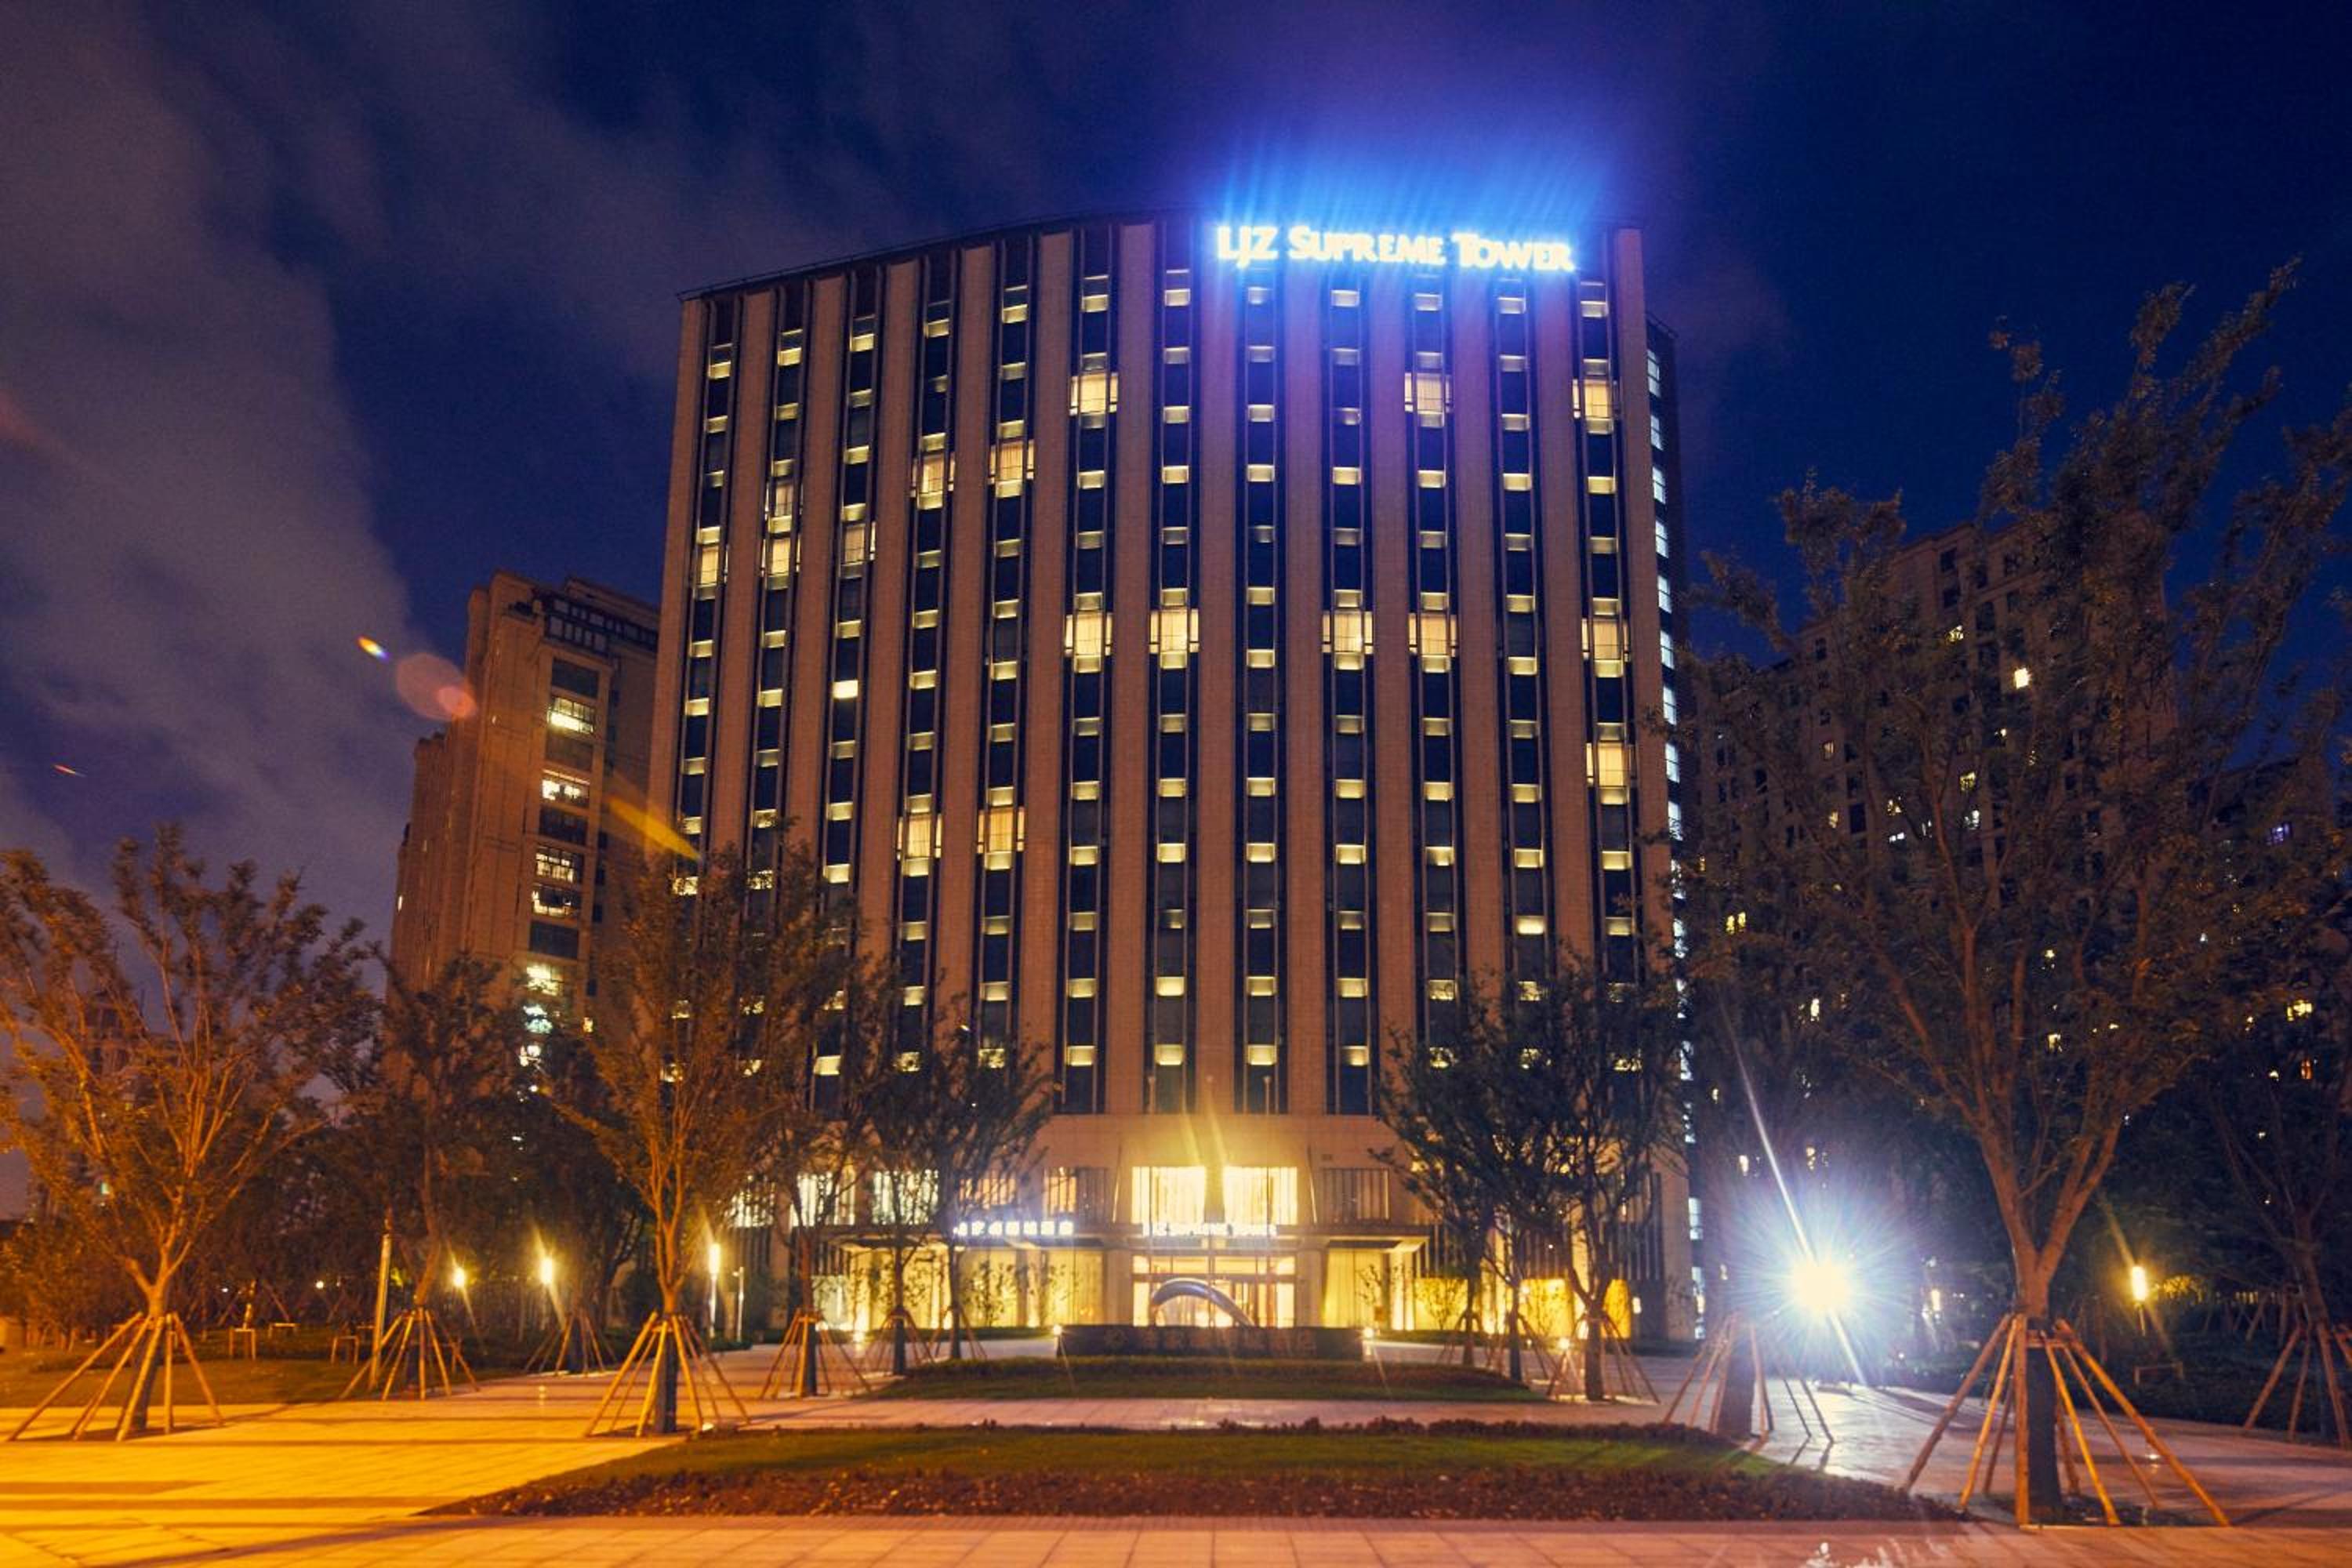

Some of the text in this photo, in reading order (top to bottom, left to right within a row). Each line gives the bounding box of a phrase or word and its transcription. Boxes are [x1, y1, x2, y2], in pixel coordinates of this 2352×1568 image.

[1216, 226, 1575, 271] LJZ SUPREME TOWER
